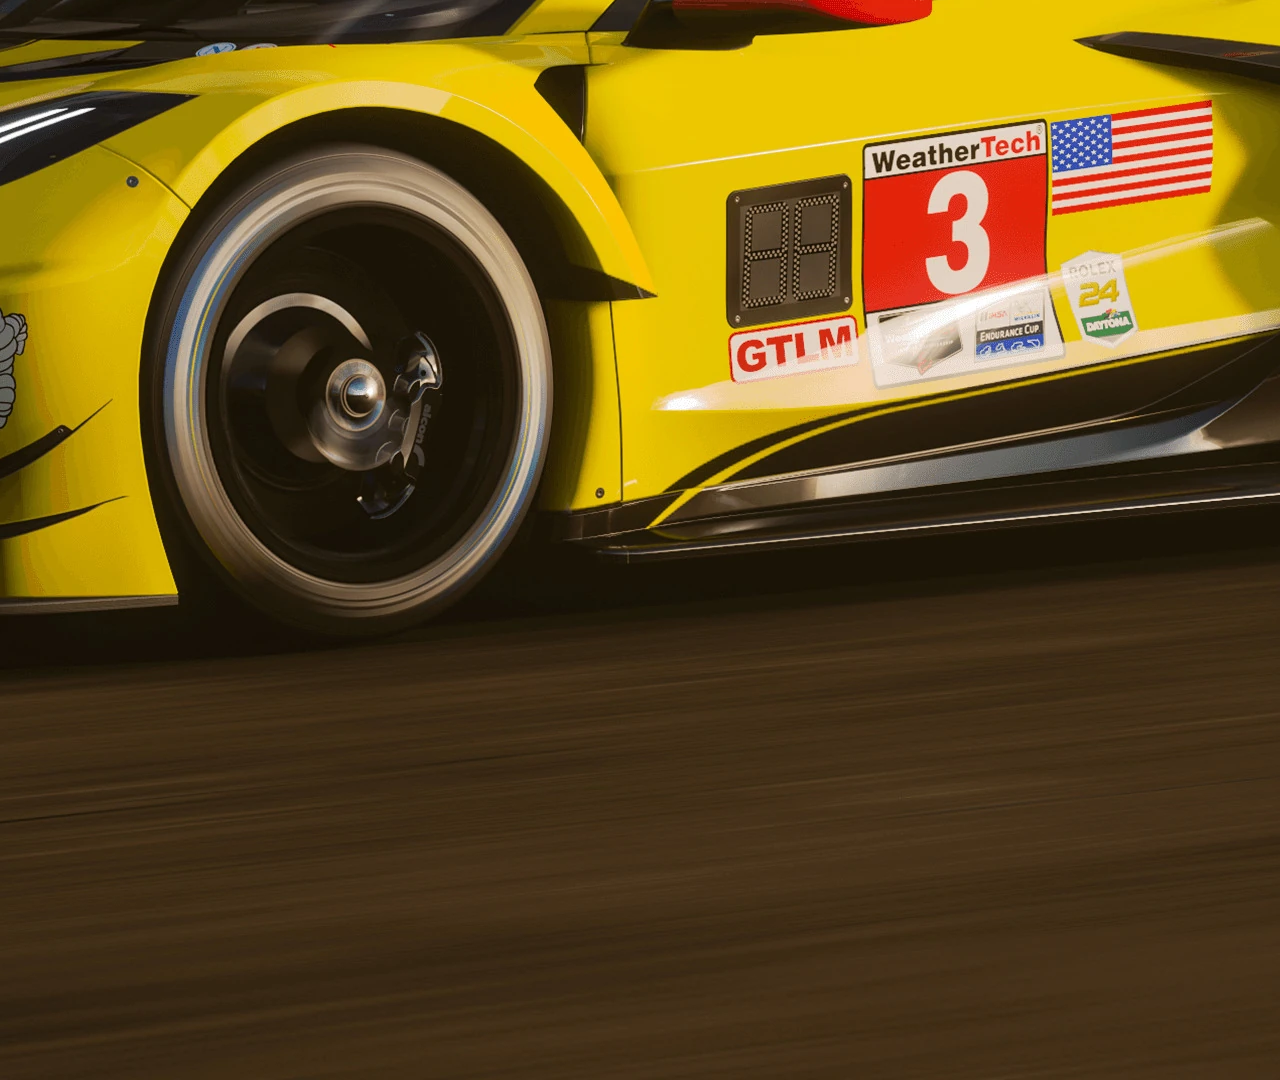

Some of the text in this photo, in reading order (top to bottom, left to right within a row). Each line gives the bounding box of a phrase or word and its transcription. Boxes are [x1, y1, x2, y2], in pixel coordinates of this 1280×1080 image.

[872, 130, 1041, 174] WeatherTech
[924, 169, 991, 295] 3
[1068, 261, 1117, 278] ROLEX
[1078, 278, 1120, 308] 24
[979, 327, 1024, 344] ENDURANCE
[1085, 316, 1132, 333] DAYTONA
[735, 325, 852, 374] GTLM
